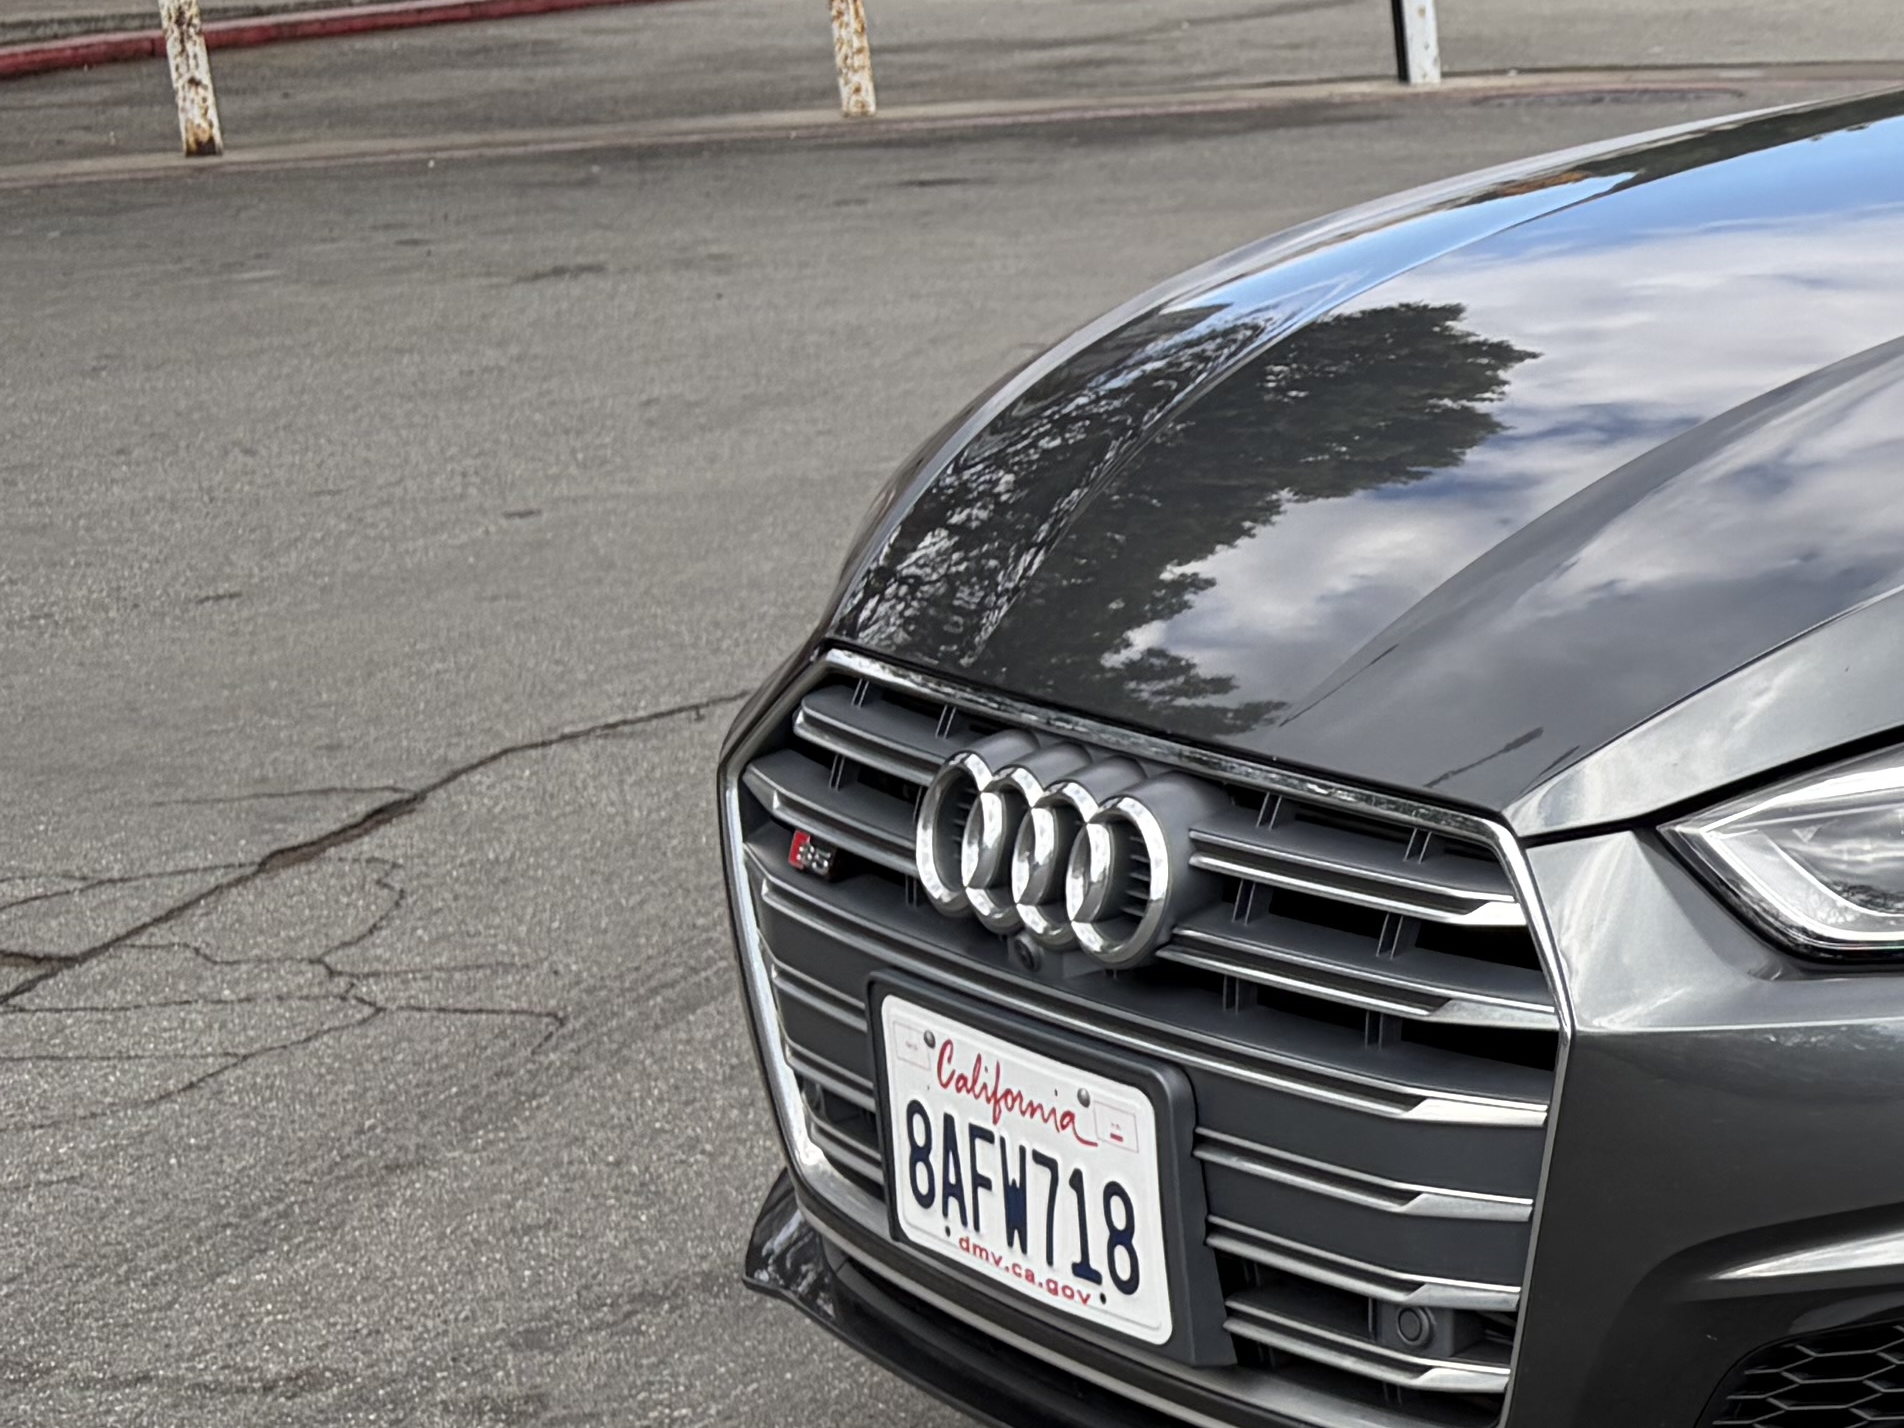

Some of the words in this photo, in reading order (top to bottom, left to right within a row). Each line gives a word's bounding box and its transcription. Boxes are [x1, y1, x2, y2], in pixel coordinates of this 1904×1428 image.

[936, 1038, 1099, 1148] California
[906, 1099, 1140, 1296] 8AFW718
[958, 1235, 1092, 1306] dmv.ca.gov
